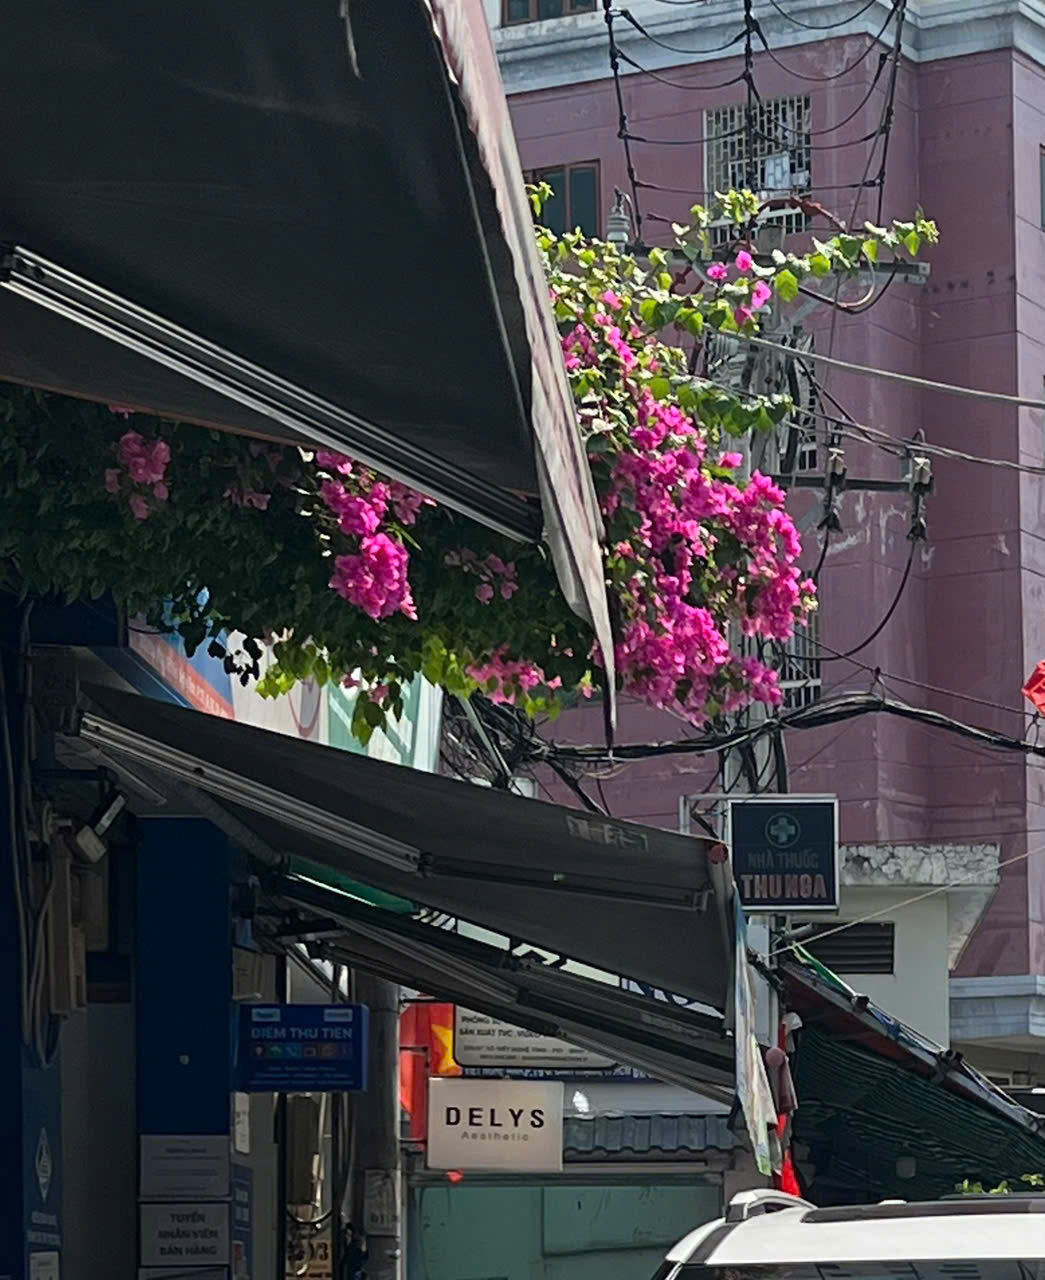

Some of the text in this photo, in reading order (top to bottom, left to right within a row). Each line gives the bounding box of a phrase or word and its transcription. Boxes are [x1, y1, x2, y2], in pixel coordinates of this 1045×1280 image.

[290, 1026, 319, 1040] THU
[445, 1106, 545, 1128] DELYS
[461, 1131, 529, 1141] Aesthetic
